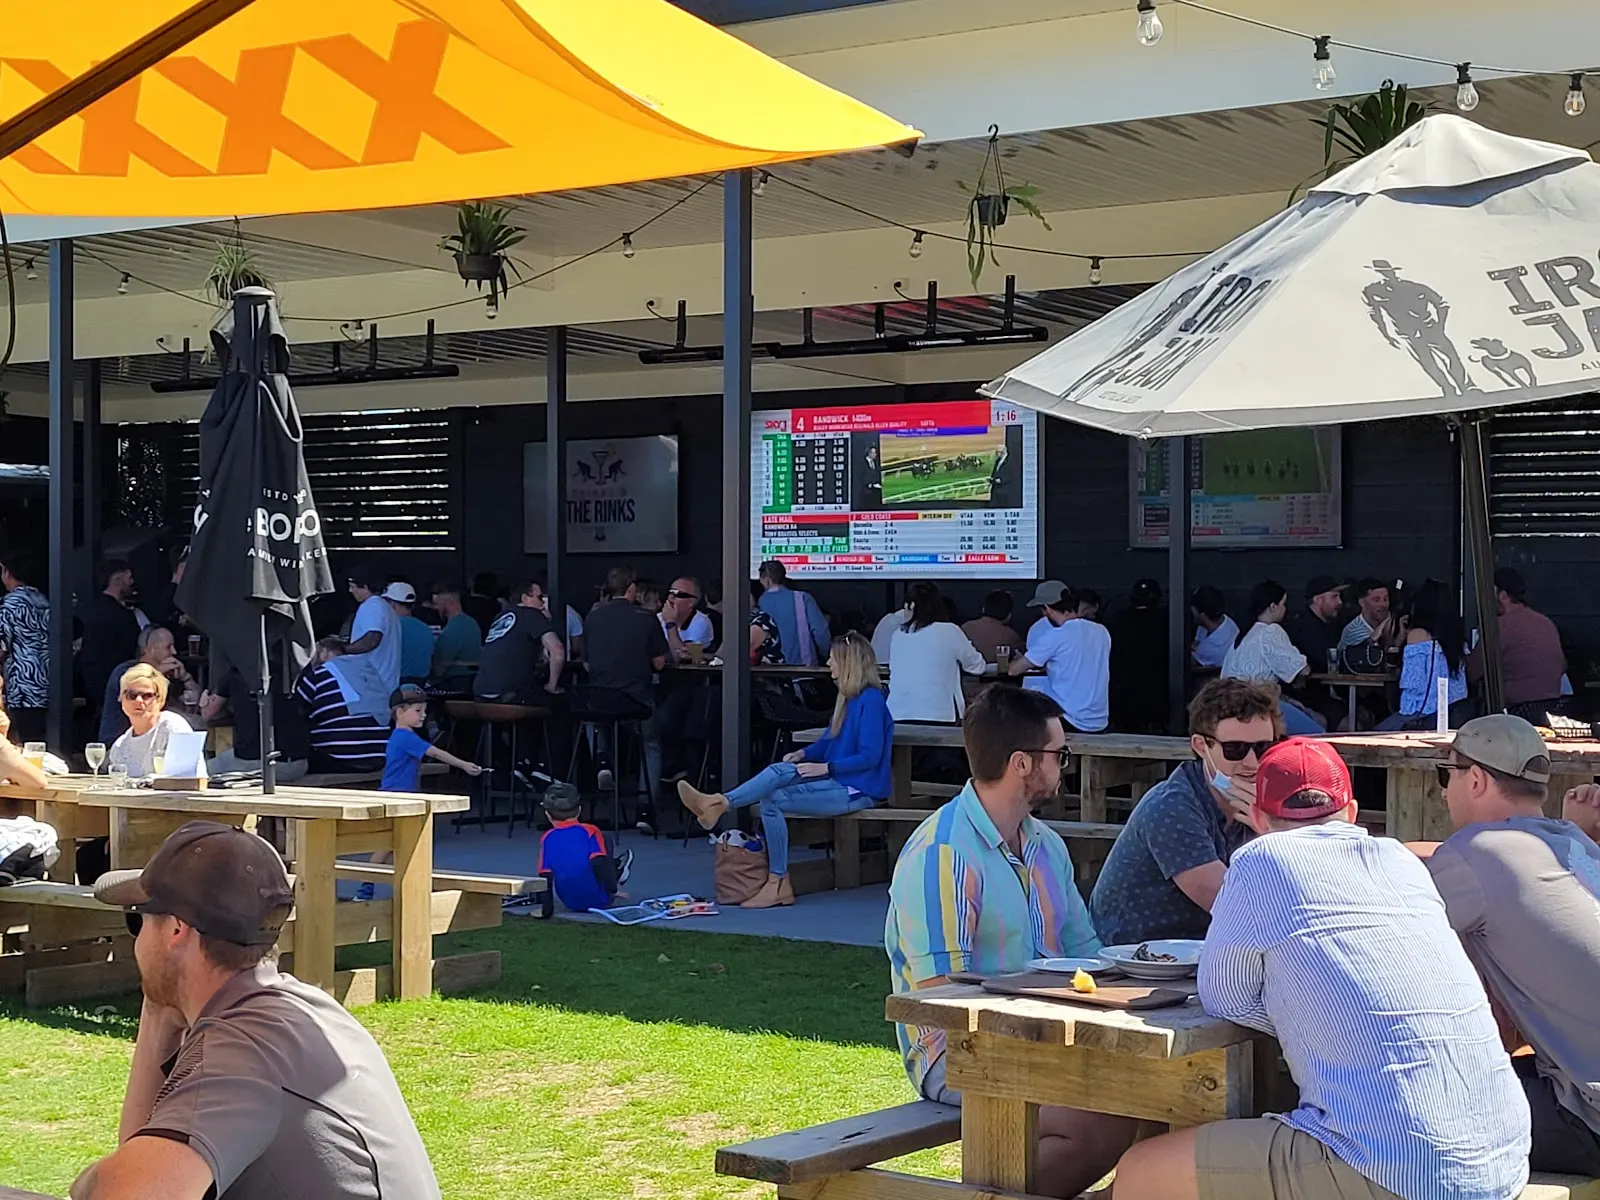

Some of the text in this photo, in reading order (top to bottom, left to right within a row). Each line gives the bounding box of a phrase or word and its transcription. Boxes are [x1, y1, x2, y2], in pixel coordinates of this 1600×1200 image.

[0, 18, 514, 178] XXX
[1487, 248, 1600, 314] IR
[796, 417, 804, 431] 4
[813, 415, 848, 424] RANDWICK
[996, 410, 1016, 421] 1:16
[566, 499, 635, 523] THE RINKS
